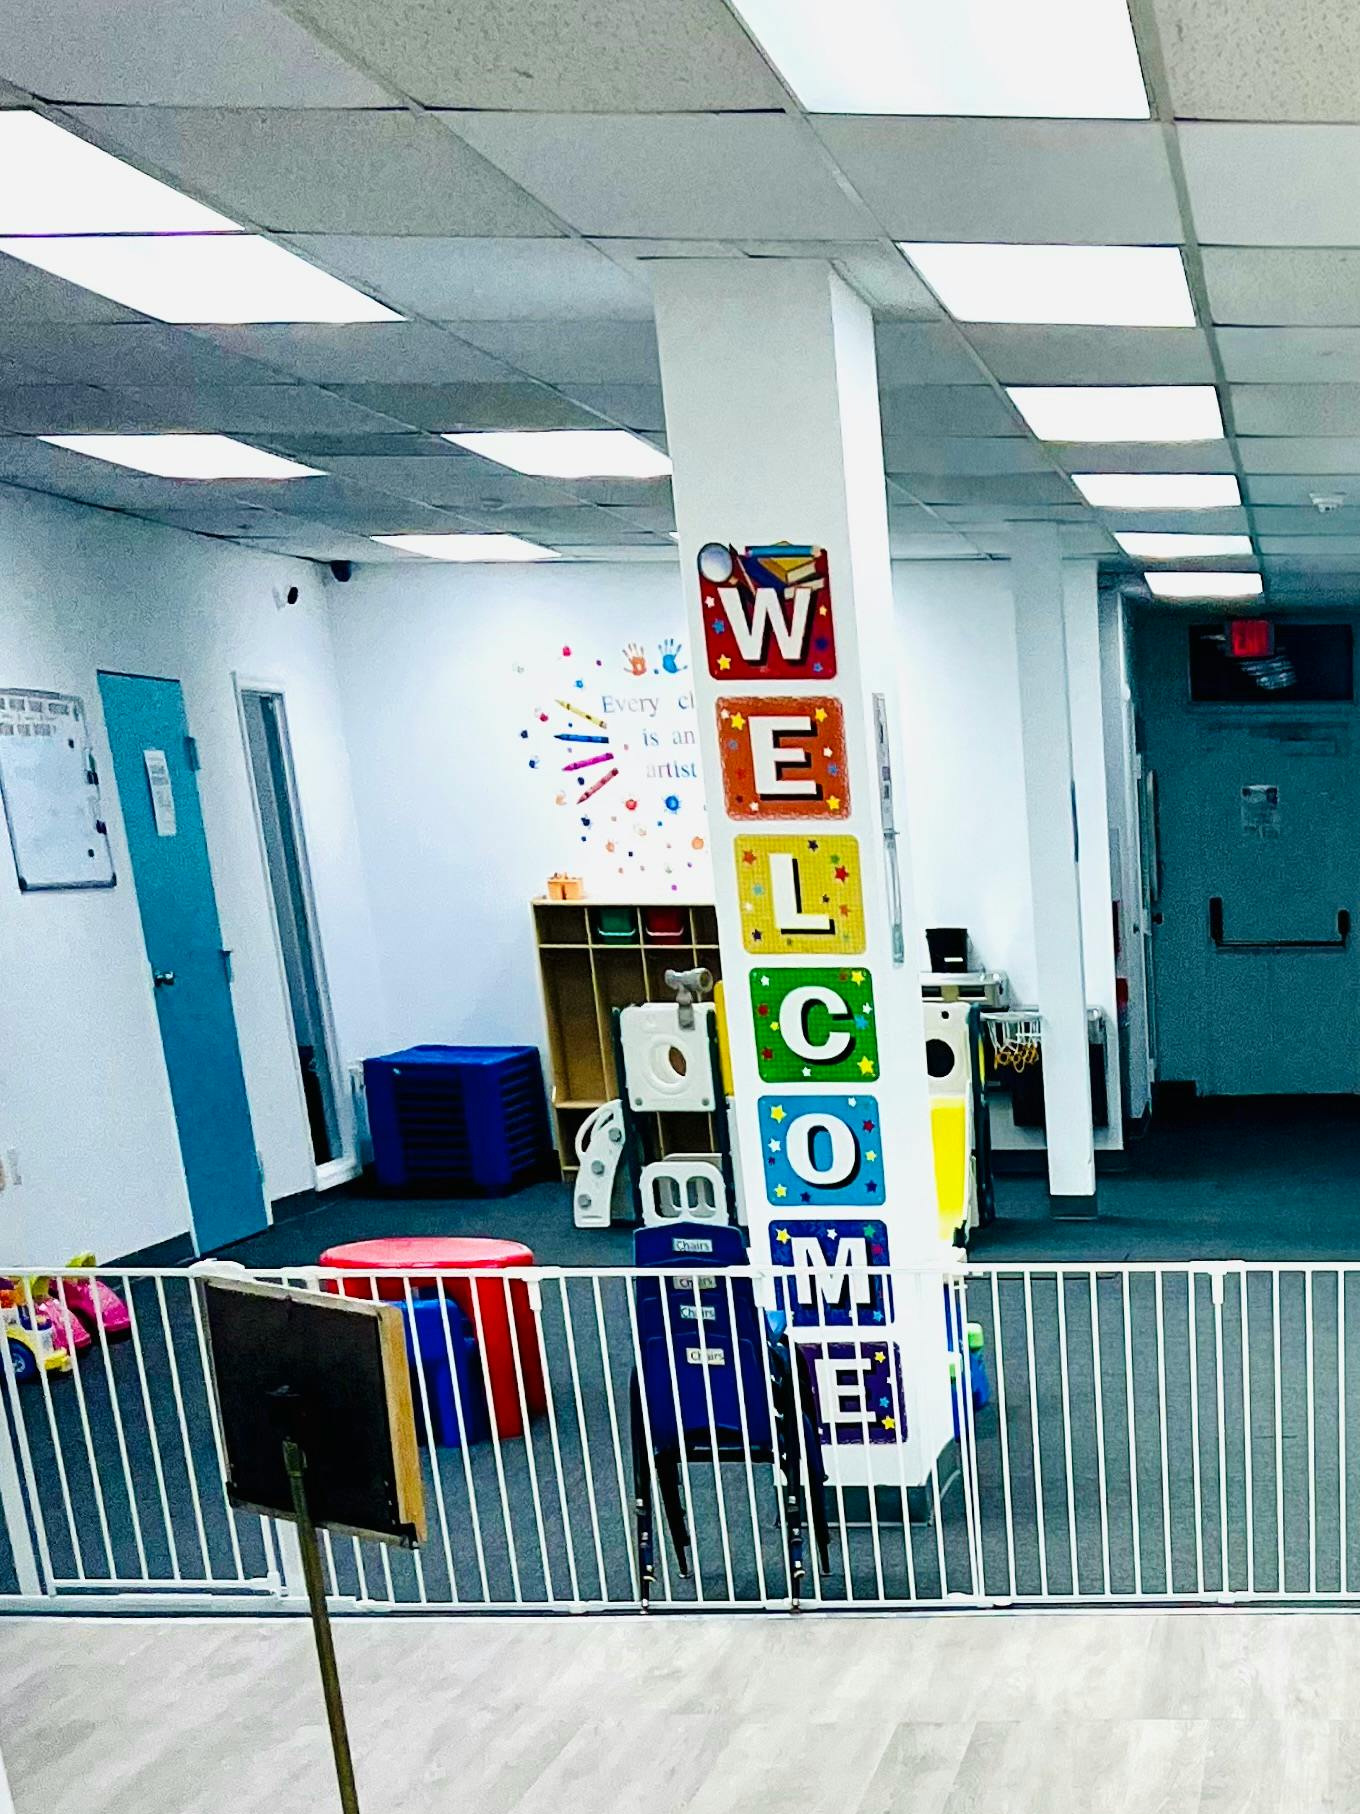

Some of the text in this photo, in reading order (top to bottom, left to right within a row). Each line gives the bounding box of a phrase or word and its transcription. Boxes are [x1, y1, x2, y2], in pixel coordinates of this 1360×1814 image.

[602, 695, 658, 717] Every
[643, 728, 696, 746] is an
[646, 761, 698, 778] artist
[676, 1240, 710, 1251] Chairs
[680, 1307, 714, 1319] Chirs
